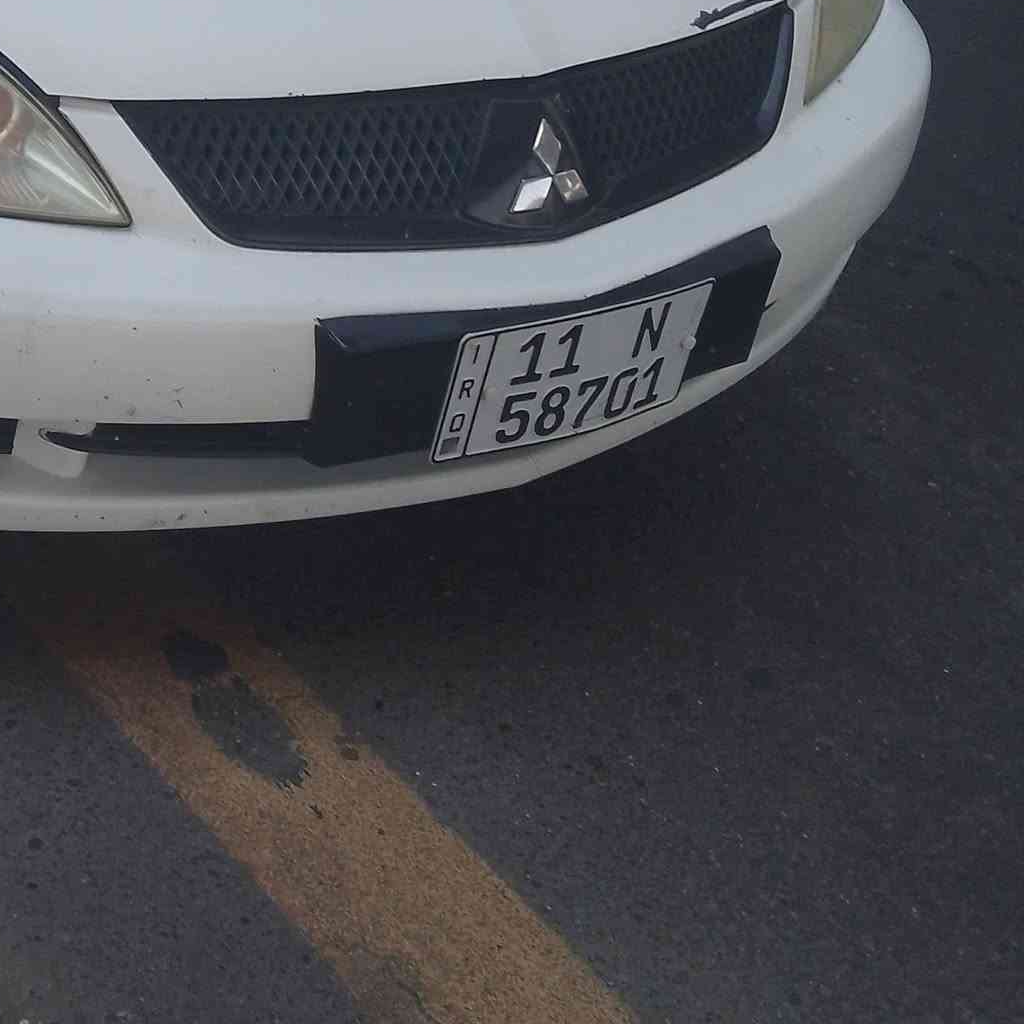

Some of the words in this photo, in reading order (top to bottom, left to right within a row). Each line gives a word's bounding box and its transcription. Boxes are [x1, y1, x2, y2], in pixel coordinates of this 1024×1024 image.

[509, 323, 585, 387] 11
[631, 300, 673, 359] N
[495, 356, 665, 444] 58701
